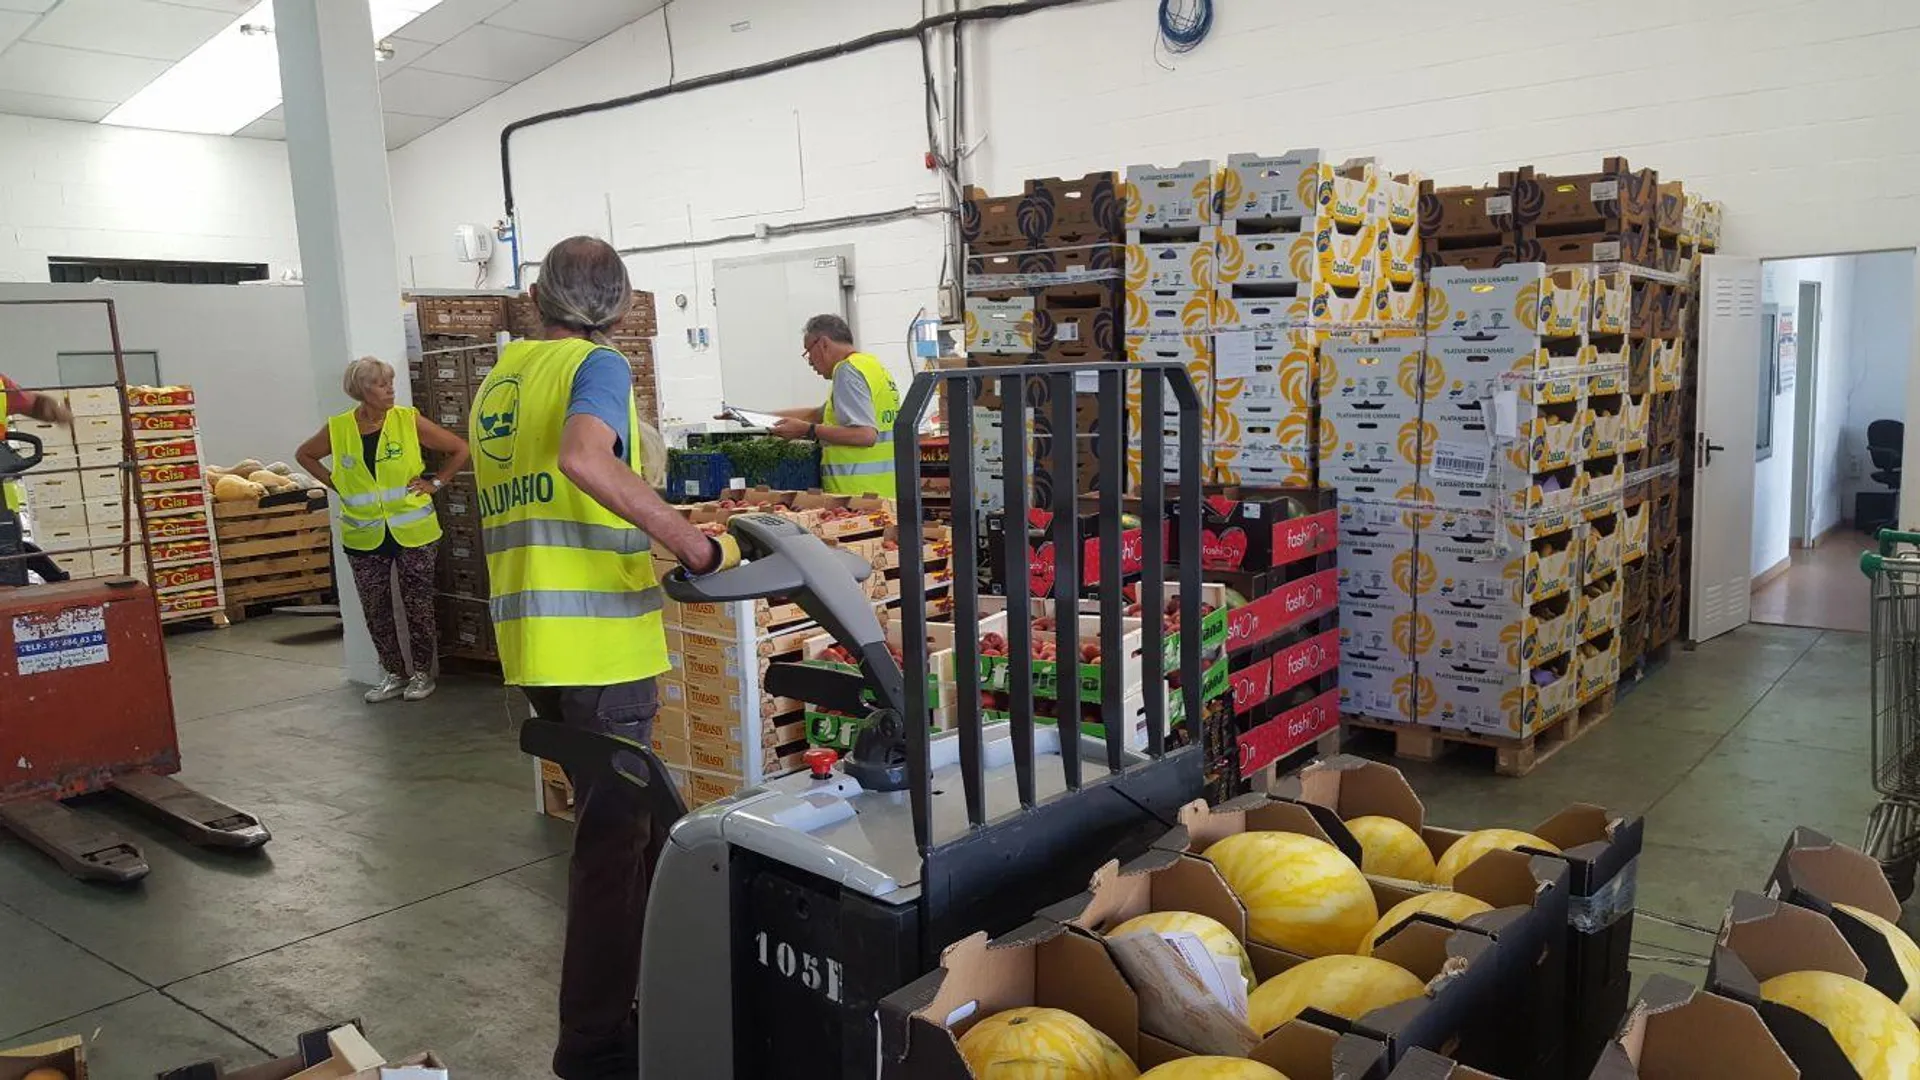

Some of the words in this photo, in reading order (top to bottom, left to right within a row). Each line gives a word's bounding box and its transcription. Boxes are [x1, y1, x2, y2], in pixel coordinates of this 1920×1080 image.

[1478, 276, 1486, 284] DE
[144, 393, 173, 406] Gisa
[146, 417, 174, 430] Gisa
[152, 446, 180, 458] Gisa
[156, 469, 184, 482] Gisa
[160, 498, 188, 509] Gisa
[170, 572, 200, 585] Gisa
[1228, 613, 1259, 640] shiOn
